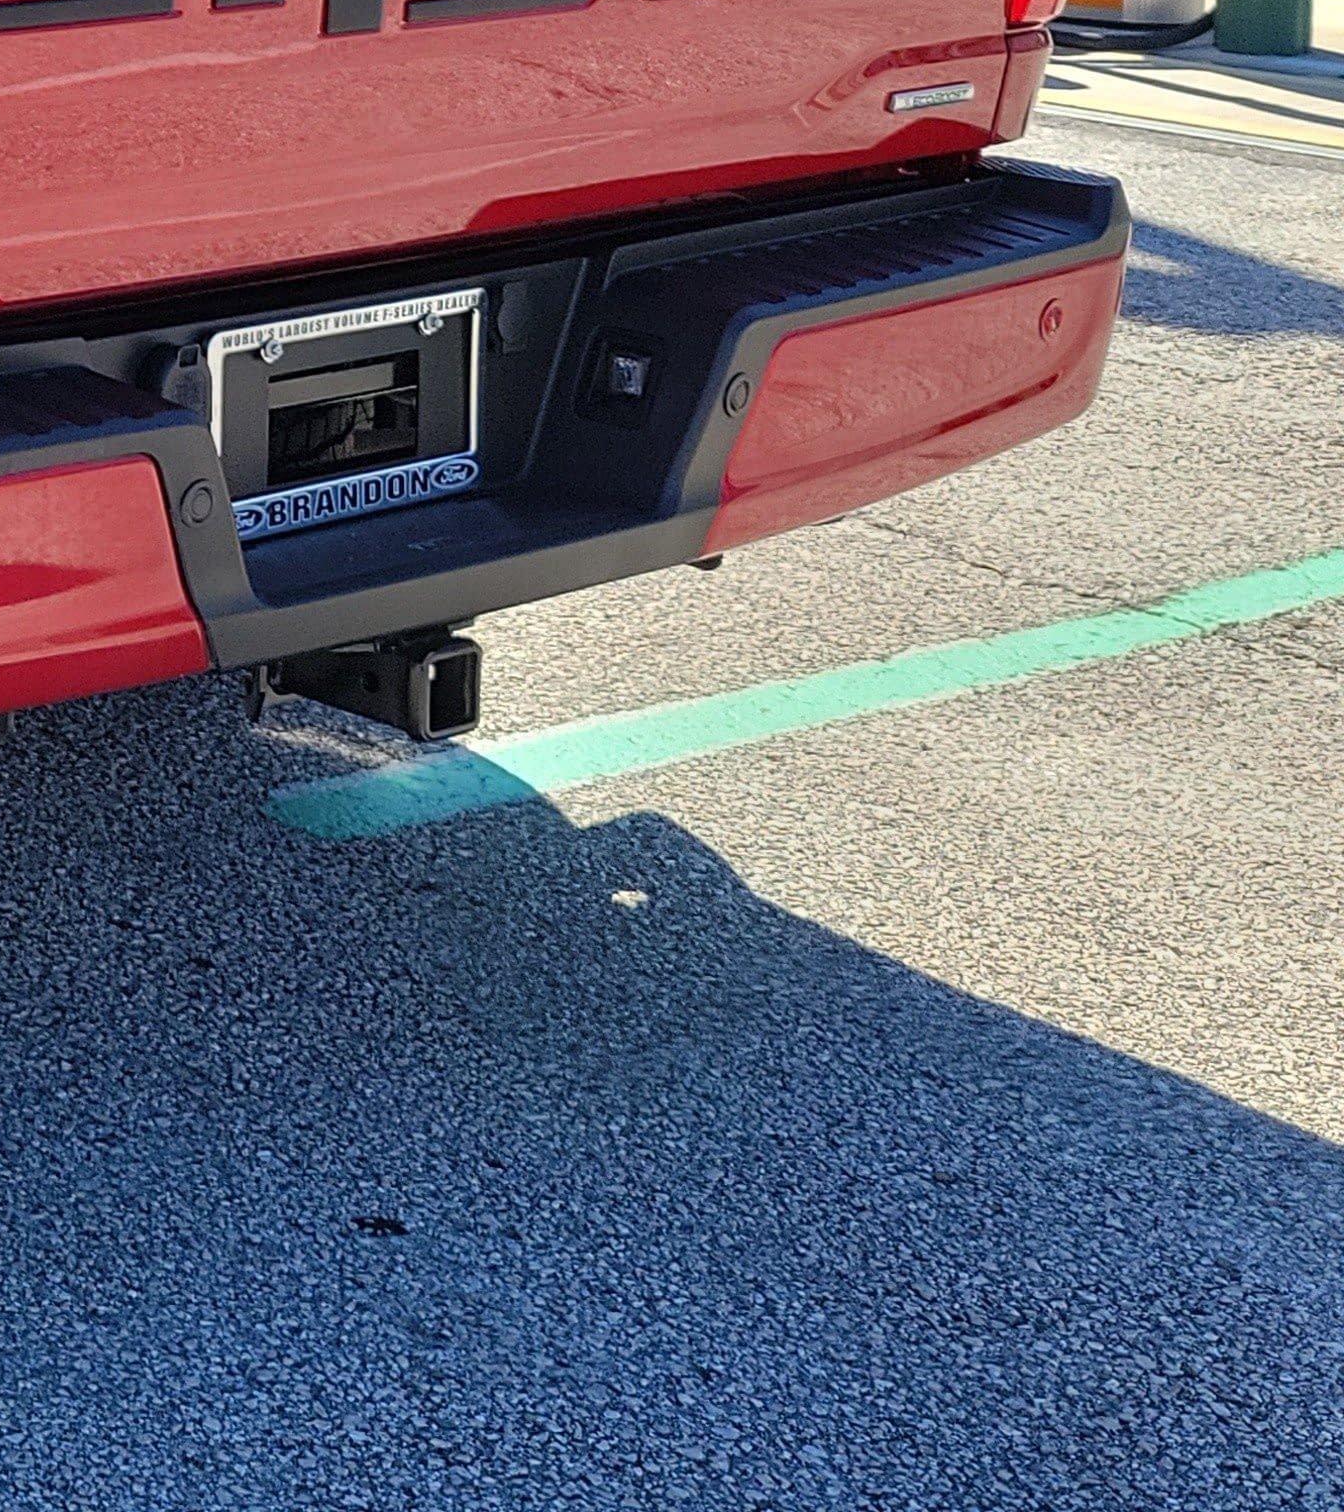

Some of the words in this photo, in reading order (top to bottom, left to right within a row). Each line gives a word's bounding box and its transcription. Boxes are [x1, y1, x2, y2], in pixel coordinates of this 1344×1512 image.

[279, 318, 330, 338] LARGEST
[333, 310, 380, 329] VOLUME
[436, 294, 479, 311] DEALER
[266, 464, 433, 529] BRANDON
